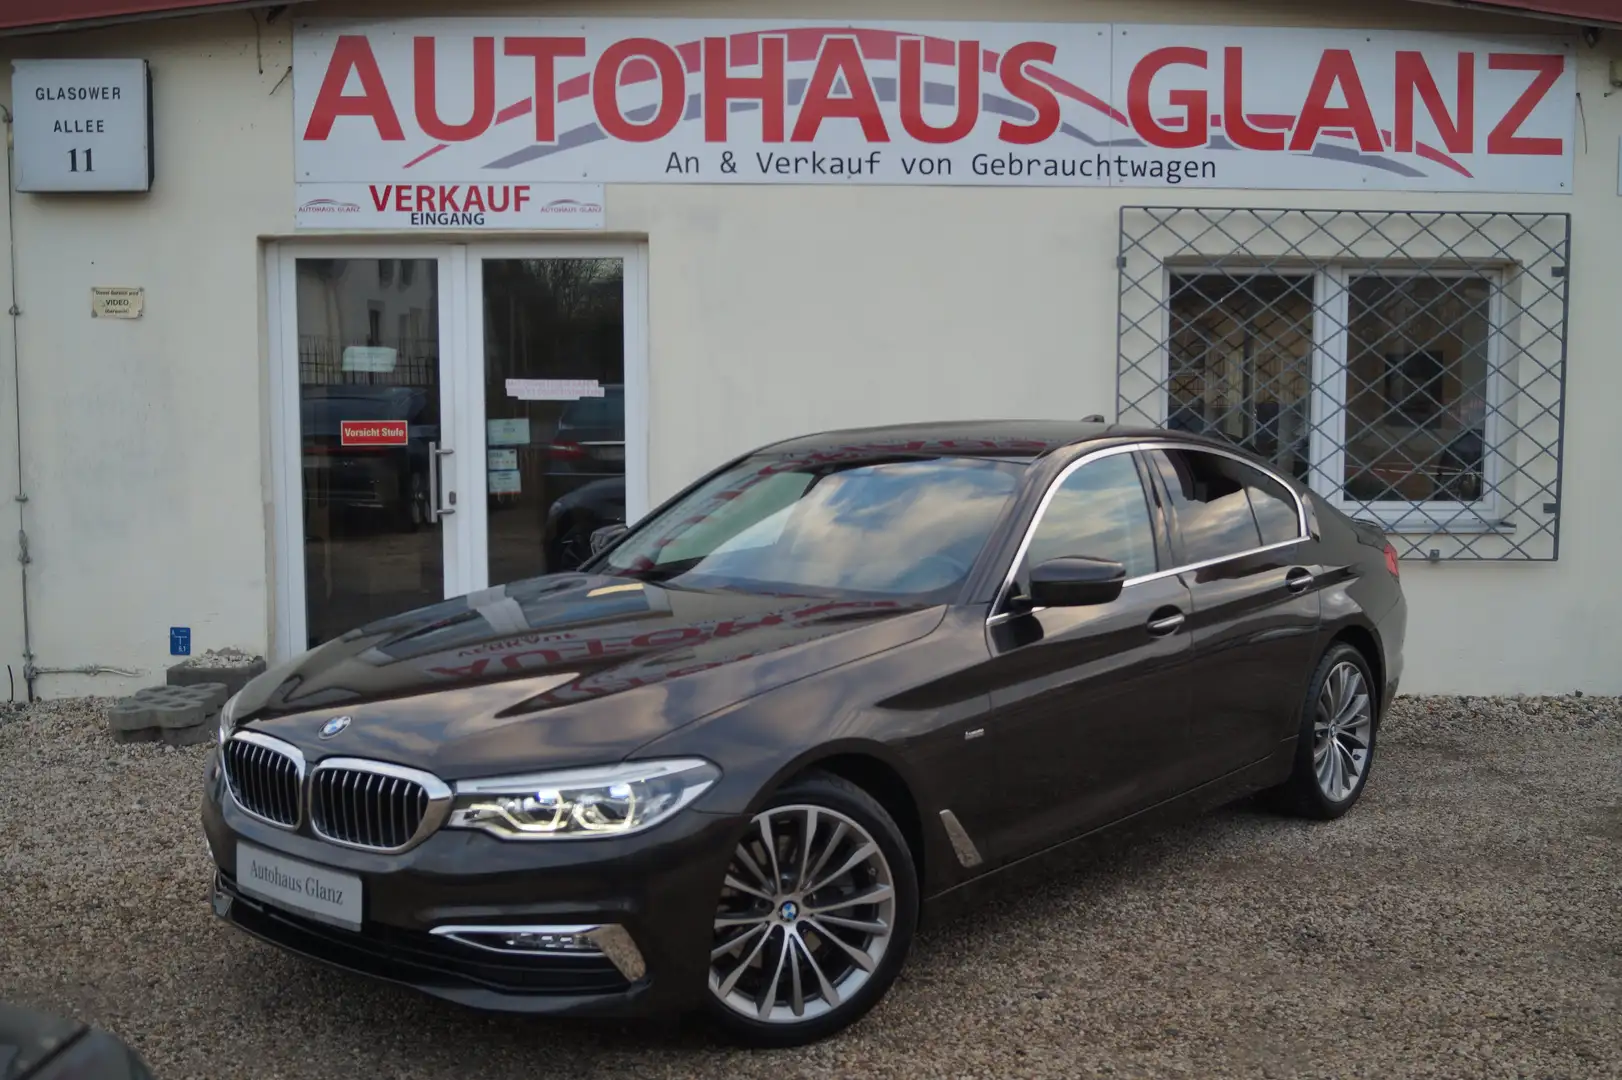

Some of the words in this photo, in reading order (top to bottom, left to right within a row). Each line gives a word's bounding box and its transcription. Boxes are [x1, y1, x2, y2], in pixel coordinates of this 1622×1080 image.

[35, 86, 121, 101] GLASOWER
[303, 35, 1061, 144] AUTOHAUS
[1127, 46, 1565, 156] GLANZ
[53, 119, 105, 134] ALLEE
[67, 147, 95, 173] 11
[665, 151, 700, 174] An
[720, 151, 737, 174] &
[756, 150, 881, 175] Verkauf
[901, 157, 952, 175] von
[972, 152, 1217, 184] Gebrauchtwagen
[369, 185, 531, 212] VERKAUF
[410, 212, 485, 226] EINGANG
[344, 427, 380, 437] Vorsicht
[381, 427, 404, 437] Stufe
[251, 859, 302, 894] Autohaus
[305, 876, 344, 906] Glanz
